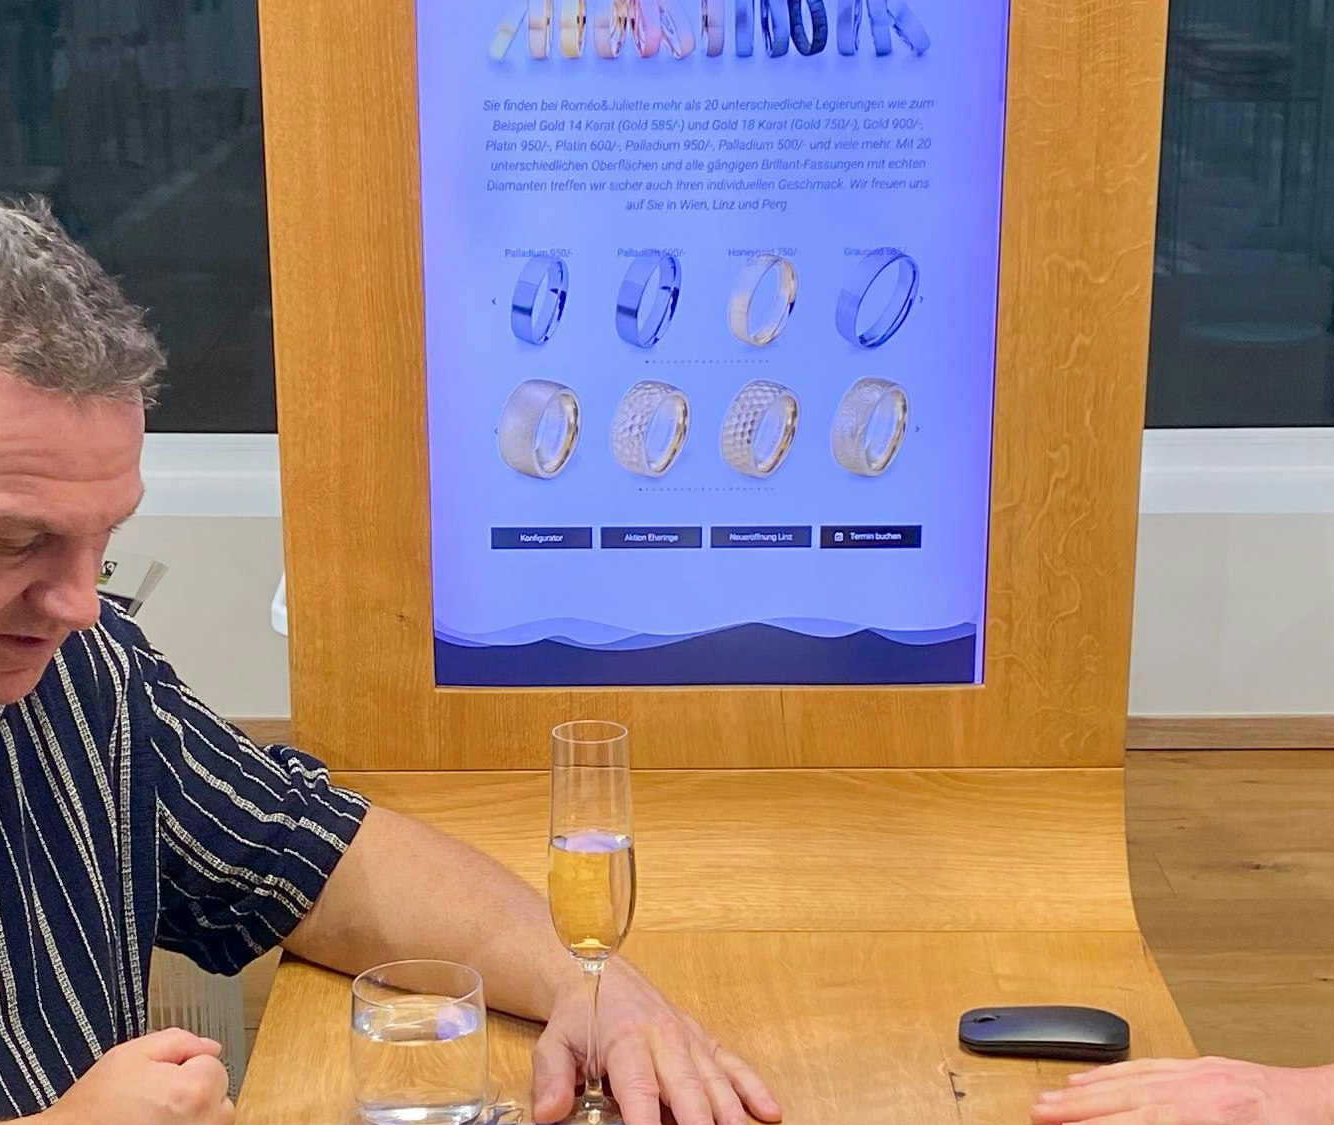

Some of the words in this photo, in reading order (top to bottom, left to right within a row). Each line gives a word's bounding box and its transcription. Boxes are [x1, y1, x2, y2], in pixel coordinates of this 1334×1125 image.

[483, 100, 500, 111] Sie
[503, 100, 538, 111] finden
[541, 100, 557, 111] bei
[561, 99, 649, 110] Roméo&Juliette
[653, 99, 682, 110] mehr
[685, 99, 701, 110] als
[705, 99, 718, 110] 20
[721, 99, 813, 110] unterschiedliche
[816, 98, 883, 111] Legierungen
[888, 98, 906, 109] wie
[909, 100, 934, 109] zum
[493, 120, 536, 133] Beispiel
[539, 120, 565, 131] Gold
[569, 119, 582, 130] 14
[585, 119, 615, 130] Karat
[618, 119, 647, 133] (Gold
[651, 119, 685, 130] 585/-)
[688, 119, 709, 130] und
[713, 119, 737, 130] Gold
[741, 119, 755, 130] 18
[758, 119, 787, 130] Karat
[791, 118, 821, 132] (Gold
[824, 118, 859, 131] 750/-),
[863, 118, 889, 129] Gold
[892, 118, 923, 130] 900/-,
[485, 140, 517, 151] Platin
[520, 140, 553, 152] 950/-,
[555, 140, 587, 151] Platin
[590, 139, 622, 152] 600/-,
[625, 139, 680, 150] Palladium
[683, 139, 715, 151] 950/-,
[719, 139, 773, 150] Palladium
[809, 138, 831, 149] und
[833, 138, 859, 149] viele
[895, 138, 913, 149] Mit
[917, 138, 931, 149] 20
[491, 160, 588, 171] unterschiedlichen
[591, 159, 657, 170] Oberflächen
[661, 159, 683, 170] und
[685, 159, 705, 170] alle
[707, 159, 759, 172] gängigen
[761, 158, 864, 172] Brillant-Fassungen
[867, 158, 885, 169] mit
[889, 158, 926, 169] echten
[487, 180, 547, 191] Diamanten
[551, 180, 587, 191] treffen
[590, 179, 607, 190] wir
[609, 179, 643, 190] sicher
[645, 179, 673, 190] auch
[676, 179, 703, 190] Ihren
[707, 179, 775, 190] individuellen
[850, 178, 867, 189] Wir
[871, 178, 906, 189] freuen
[909, 180, 929, 189] uns
[626, 200, 644, 210] auf
[647, 200, 664, 210] Sie
[667, 200, 677, 210] in
[680, 200, 709, 211] Wien,
[712, 200, 735, 210] Linz
[738, 199, 759, 210] und
[505, 249, 549, 258] Palladium
[520, 534, 564, 543] Konfigurator
[778, 532, 793, 541] Linz
[850, 532, 874, 540] Termin
[875, 532, 902, 540] buchen
